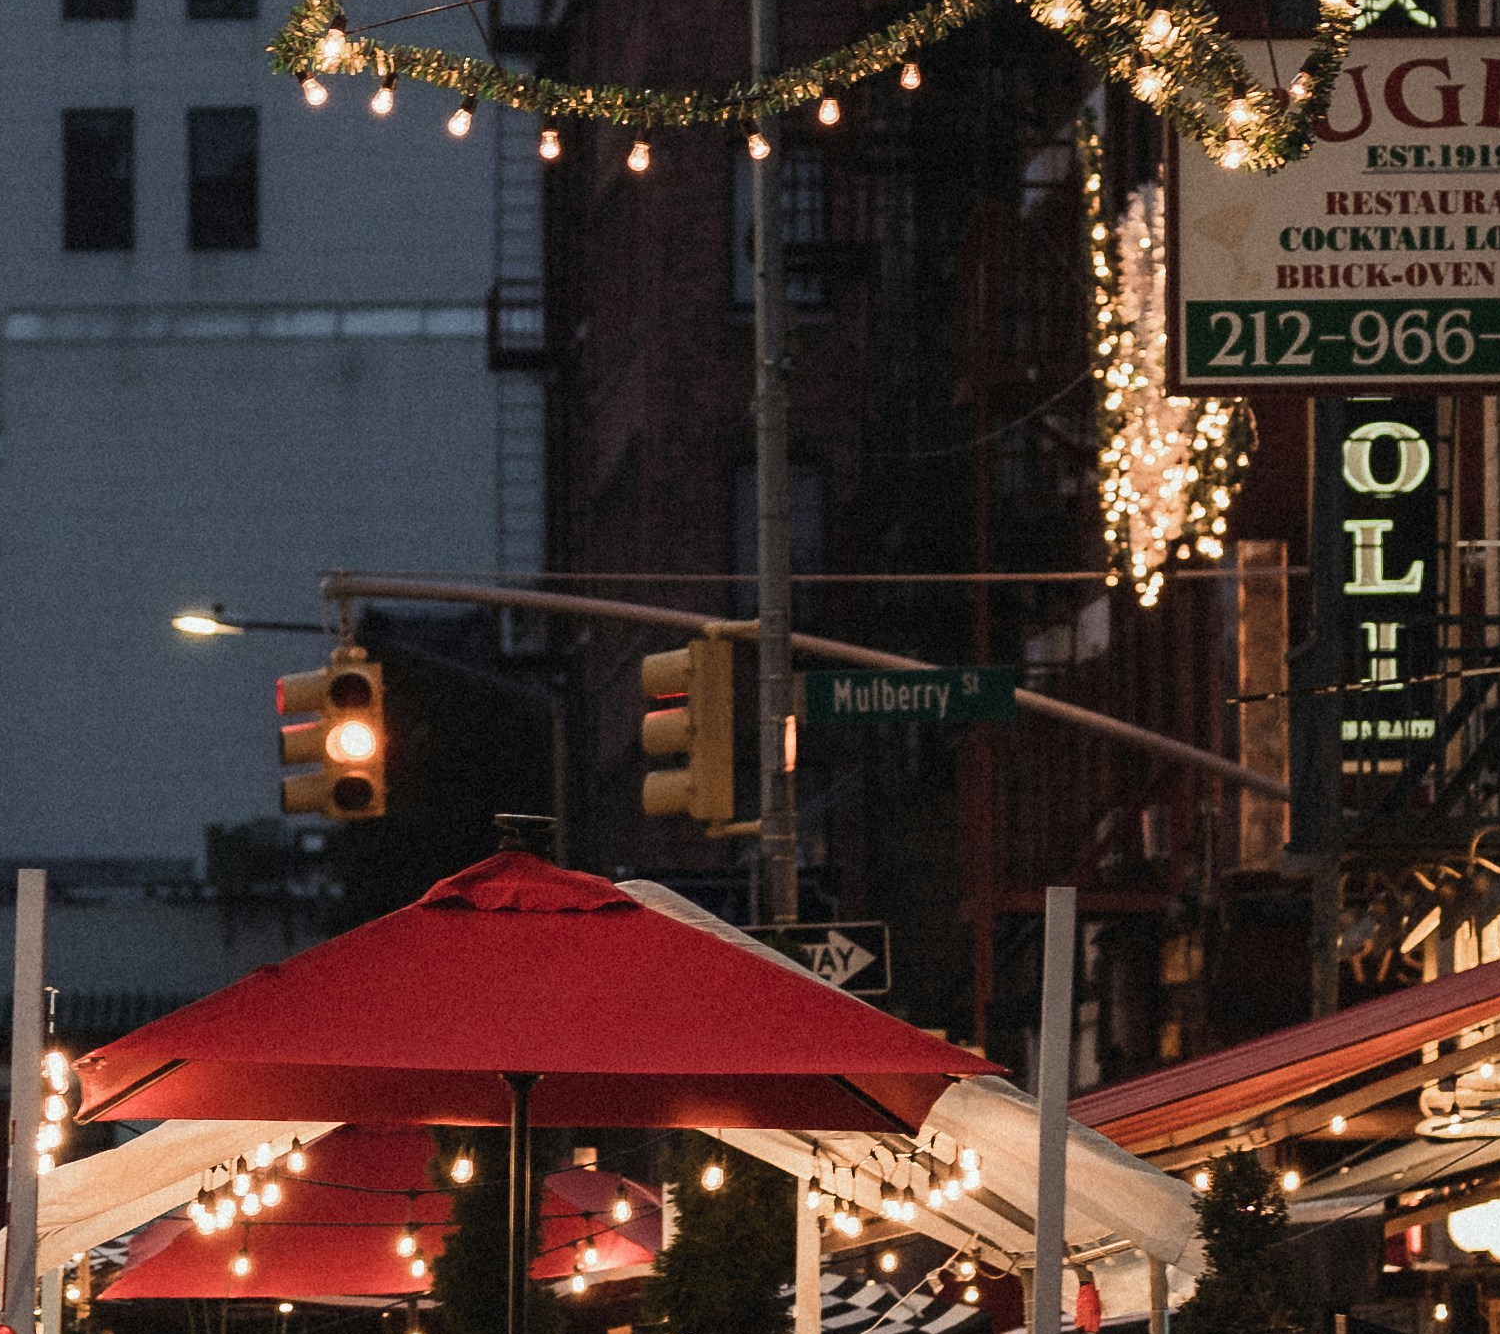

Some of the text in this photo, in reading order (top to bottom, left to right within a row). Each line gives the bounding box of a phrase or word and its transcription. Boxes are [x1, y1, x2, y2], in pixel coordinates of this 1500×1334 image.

[1280, 226, 1453, 251] COCKTAIL
[1276, 263, 1496, 289] BRICK-OVEN
[834, 673, 980, 718] Mulberry St
